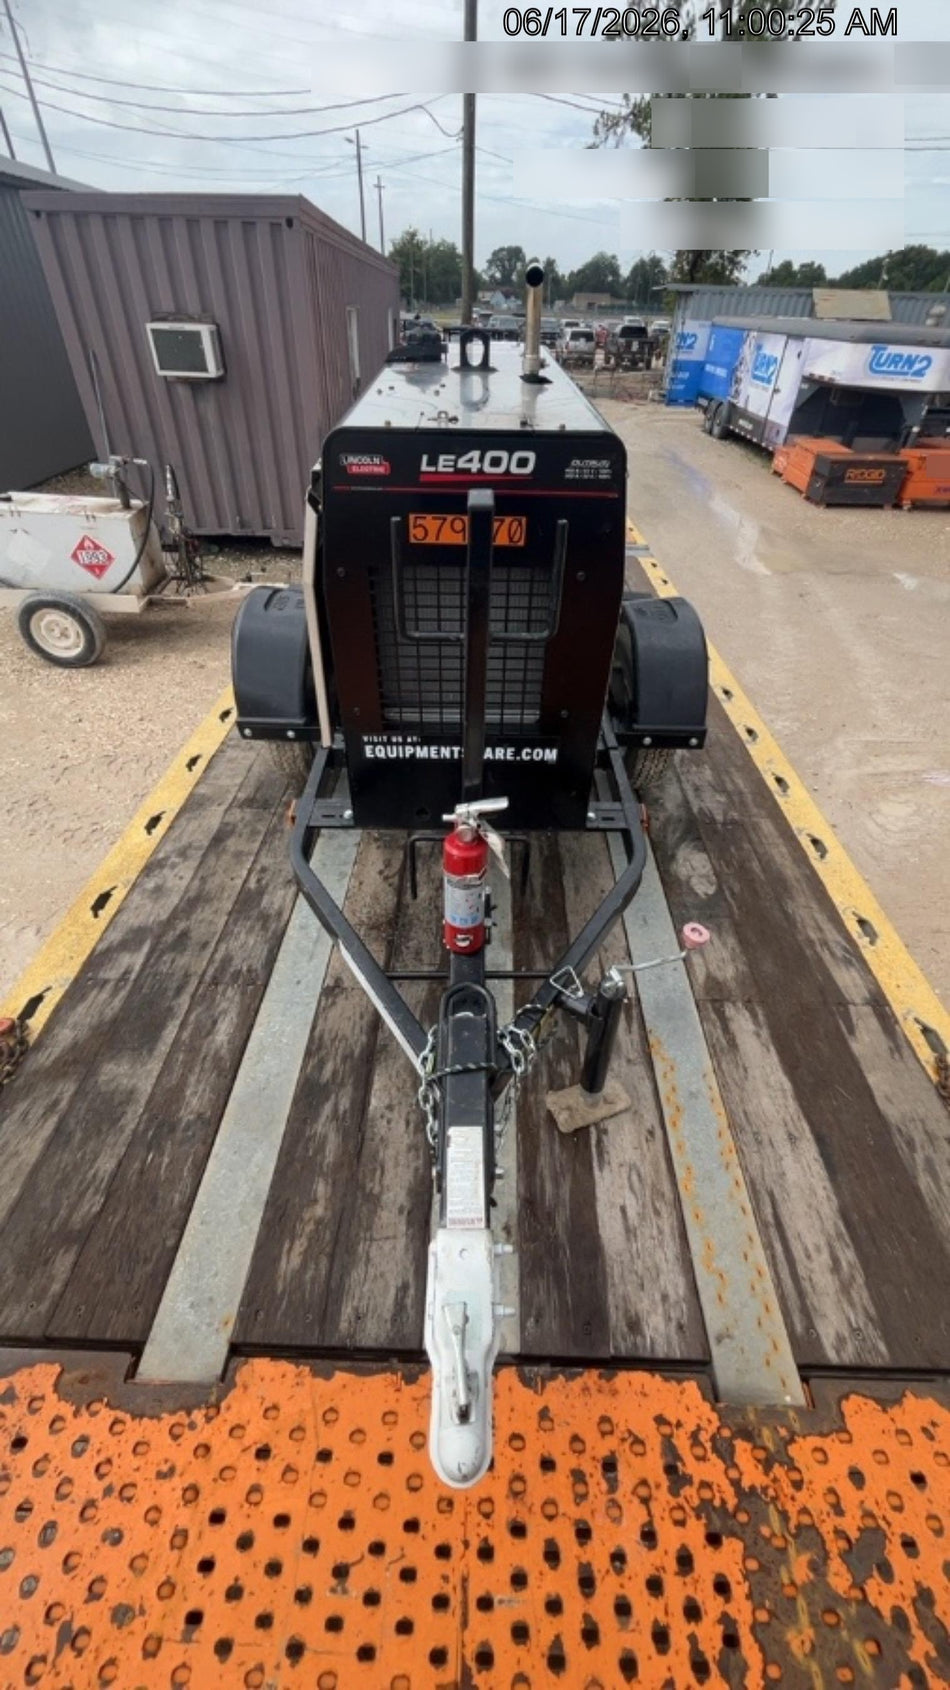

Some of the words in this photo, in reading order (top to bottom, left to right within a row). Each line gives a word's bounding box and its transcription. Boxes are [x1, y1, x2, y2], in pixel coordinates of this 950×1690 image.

[869, 344, 933, 378] TURN2
[420, 451, 536, 475] LE400
[412, 515, 523, 543] 57970
[364, 745, 558, 762] EQUIPMENTARE.COM
